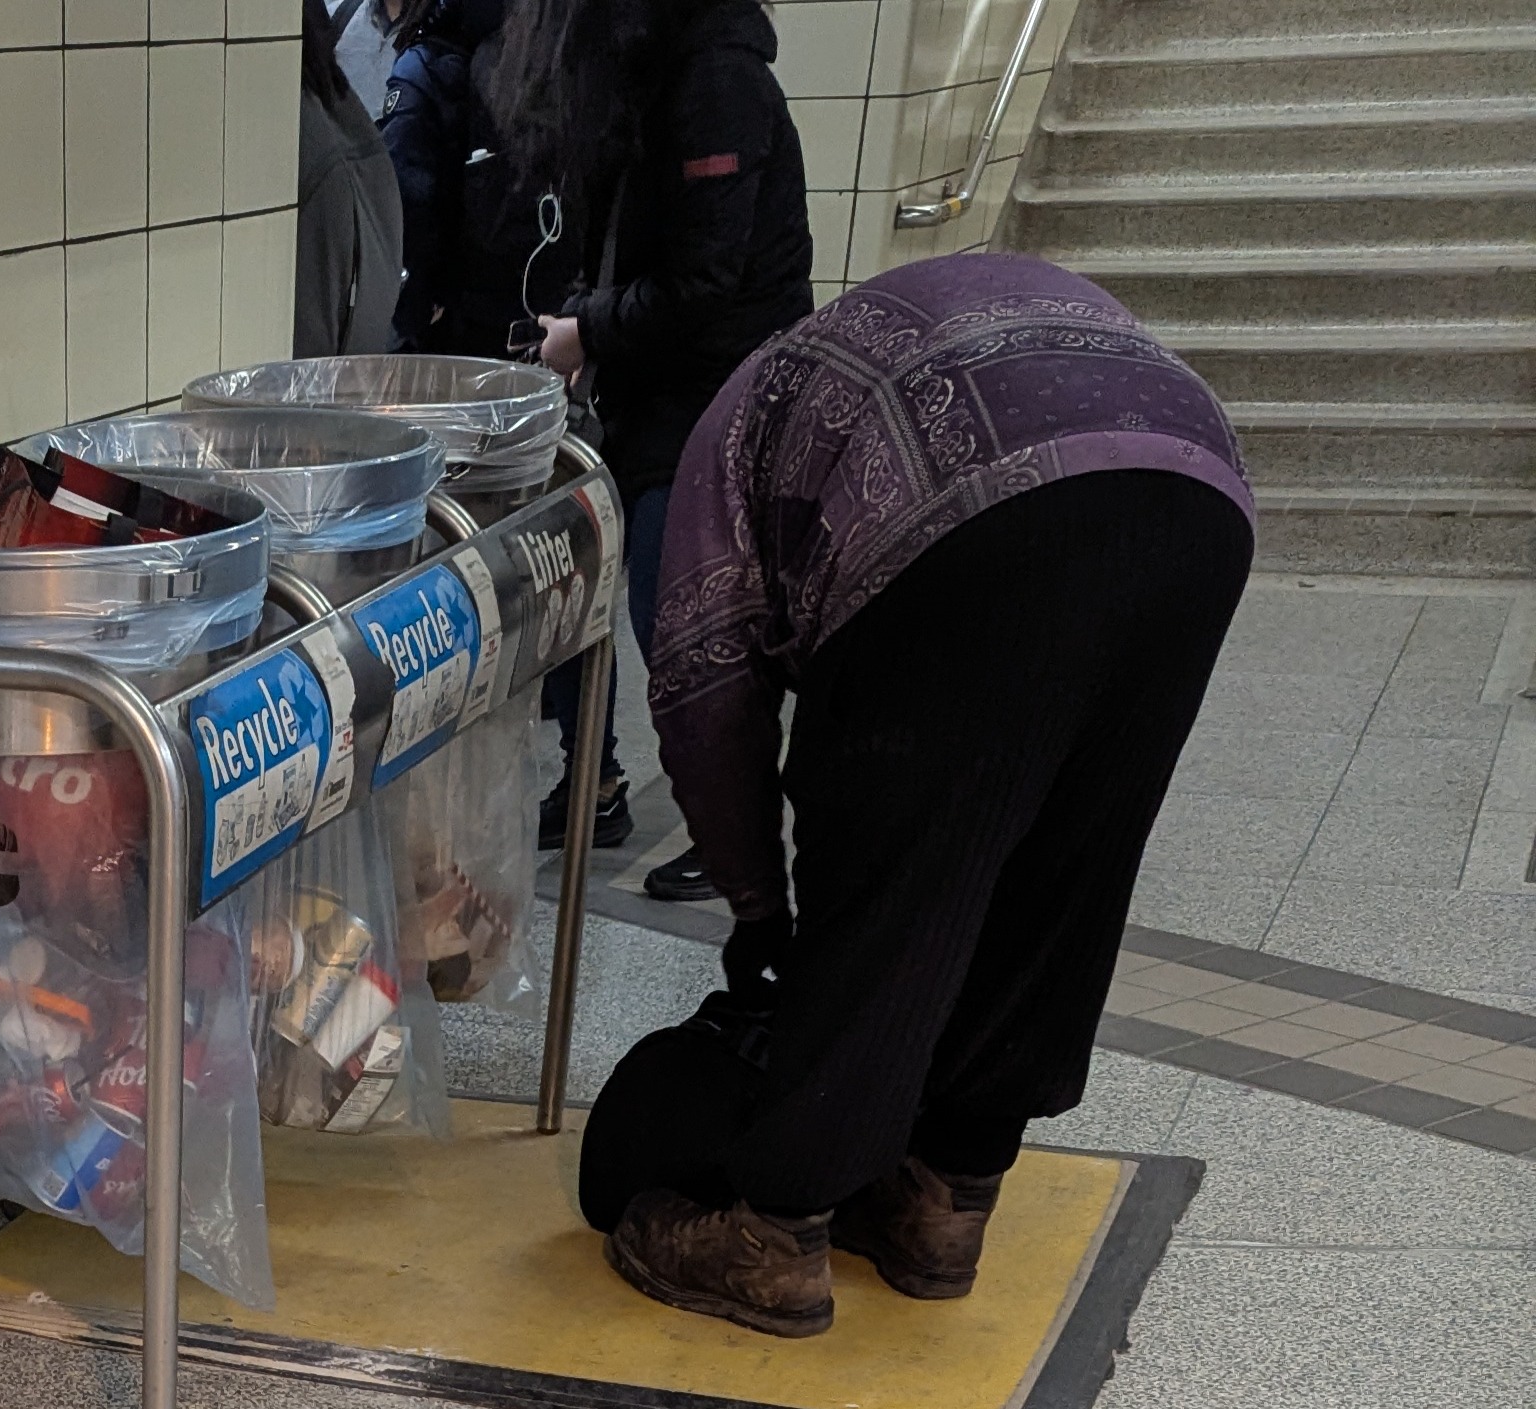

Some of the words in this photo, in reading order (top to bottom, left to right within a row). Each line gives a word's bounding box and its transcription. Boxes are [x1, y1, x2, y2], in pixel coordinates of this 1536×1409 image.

[517, 528, 575, 595] Litter
[366, 589, 454, 688] Recycle
[196, 677, 299, 791] Recycle
